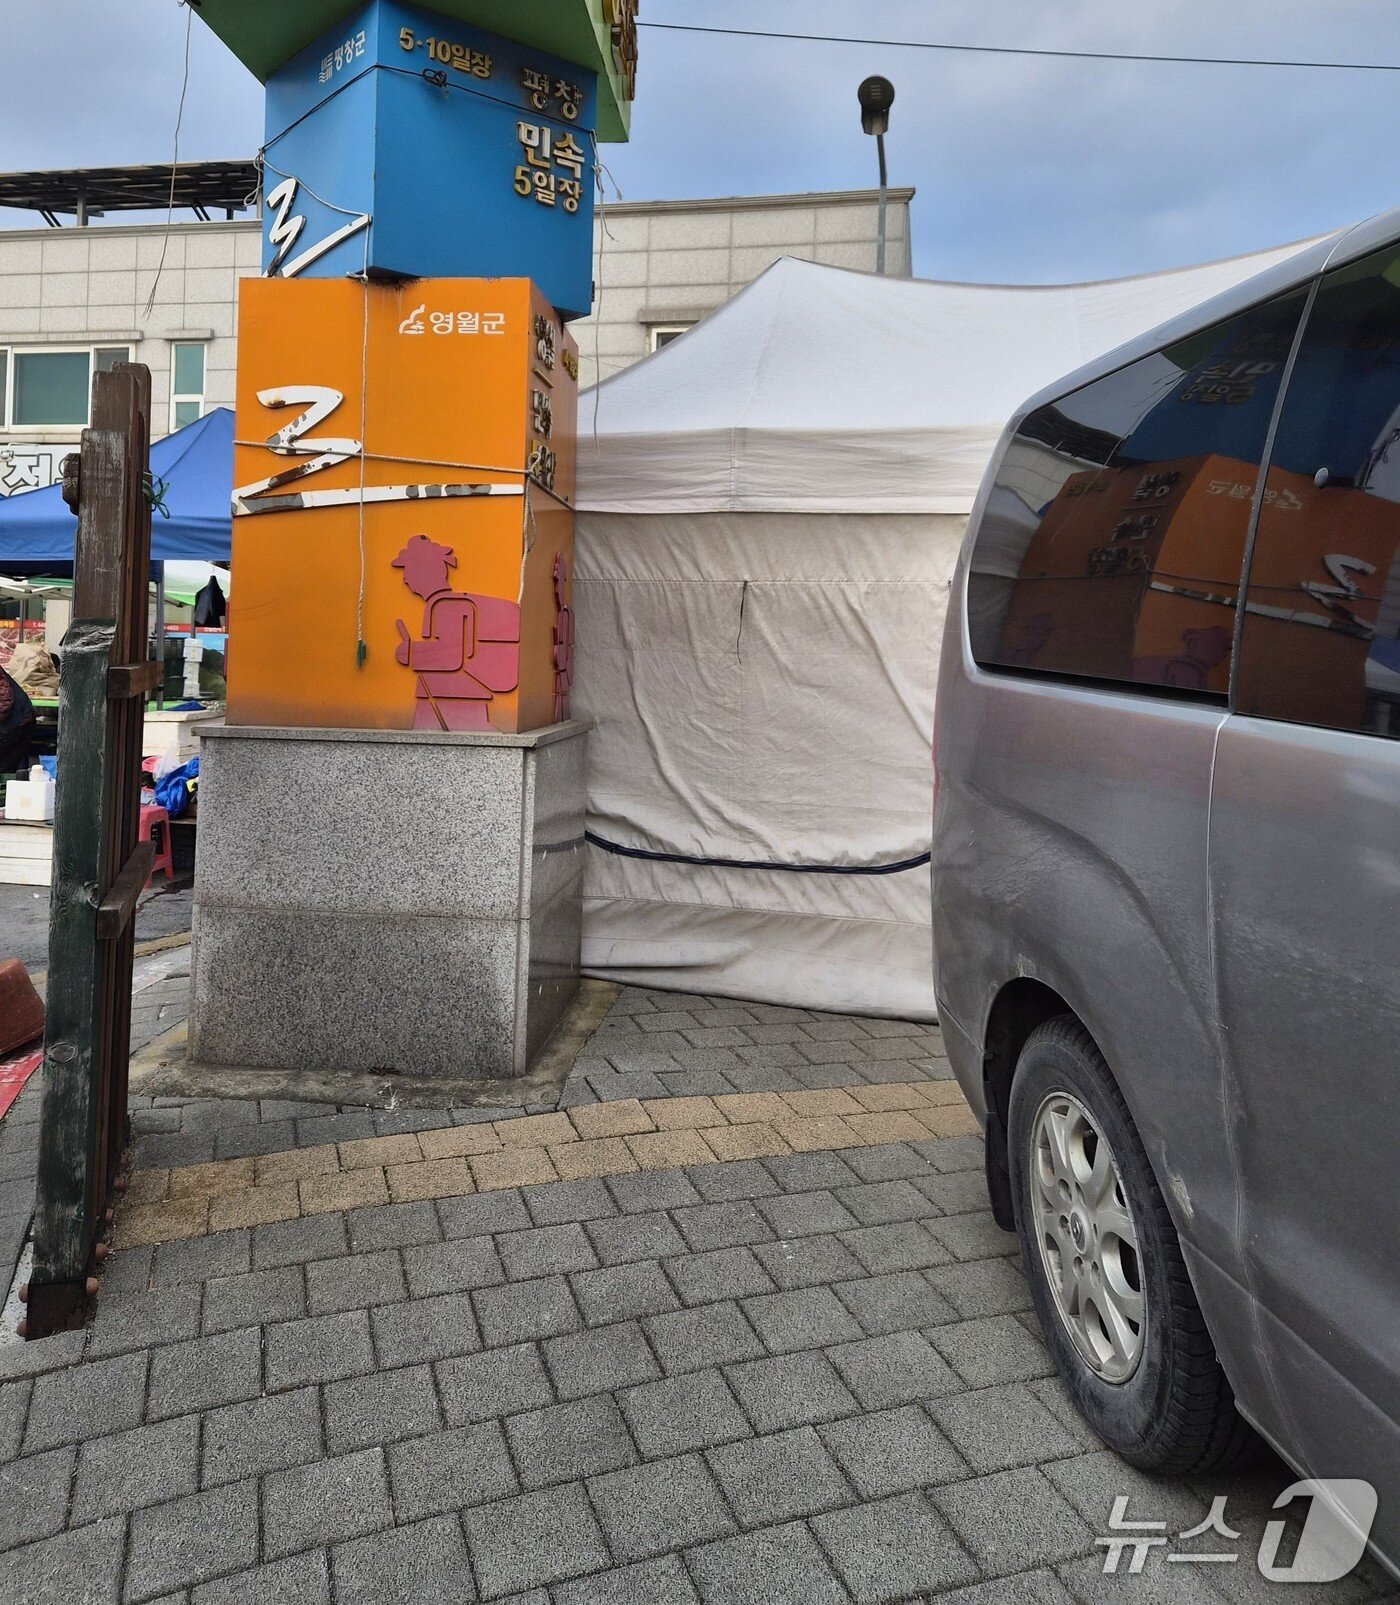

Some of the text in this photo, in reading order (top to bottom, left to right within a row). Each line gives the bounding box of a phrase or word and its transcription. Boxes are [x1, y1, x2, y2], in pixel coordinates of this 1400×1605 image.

[333, 30, 366, 71] 평창군
[521, 67, 583, 120] 평창
[517, 121, 585, 179] 민속
[513, 165, 583, 213] 5일장
[429, 311, 505, 335] 영월군
